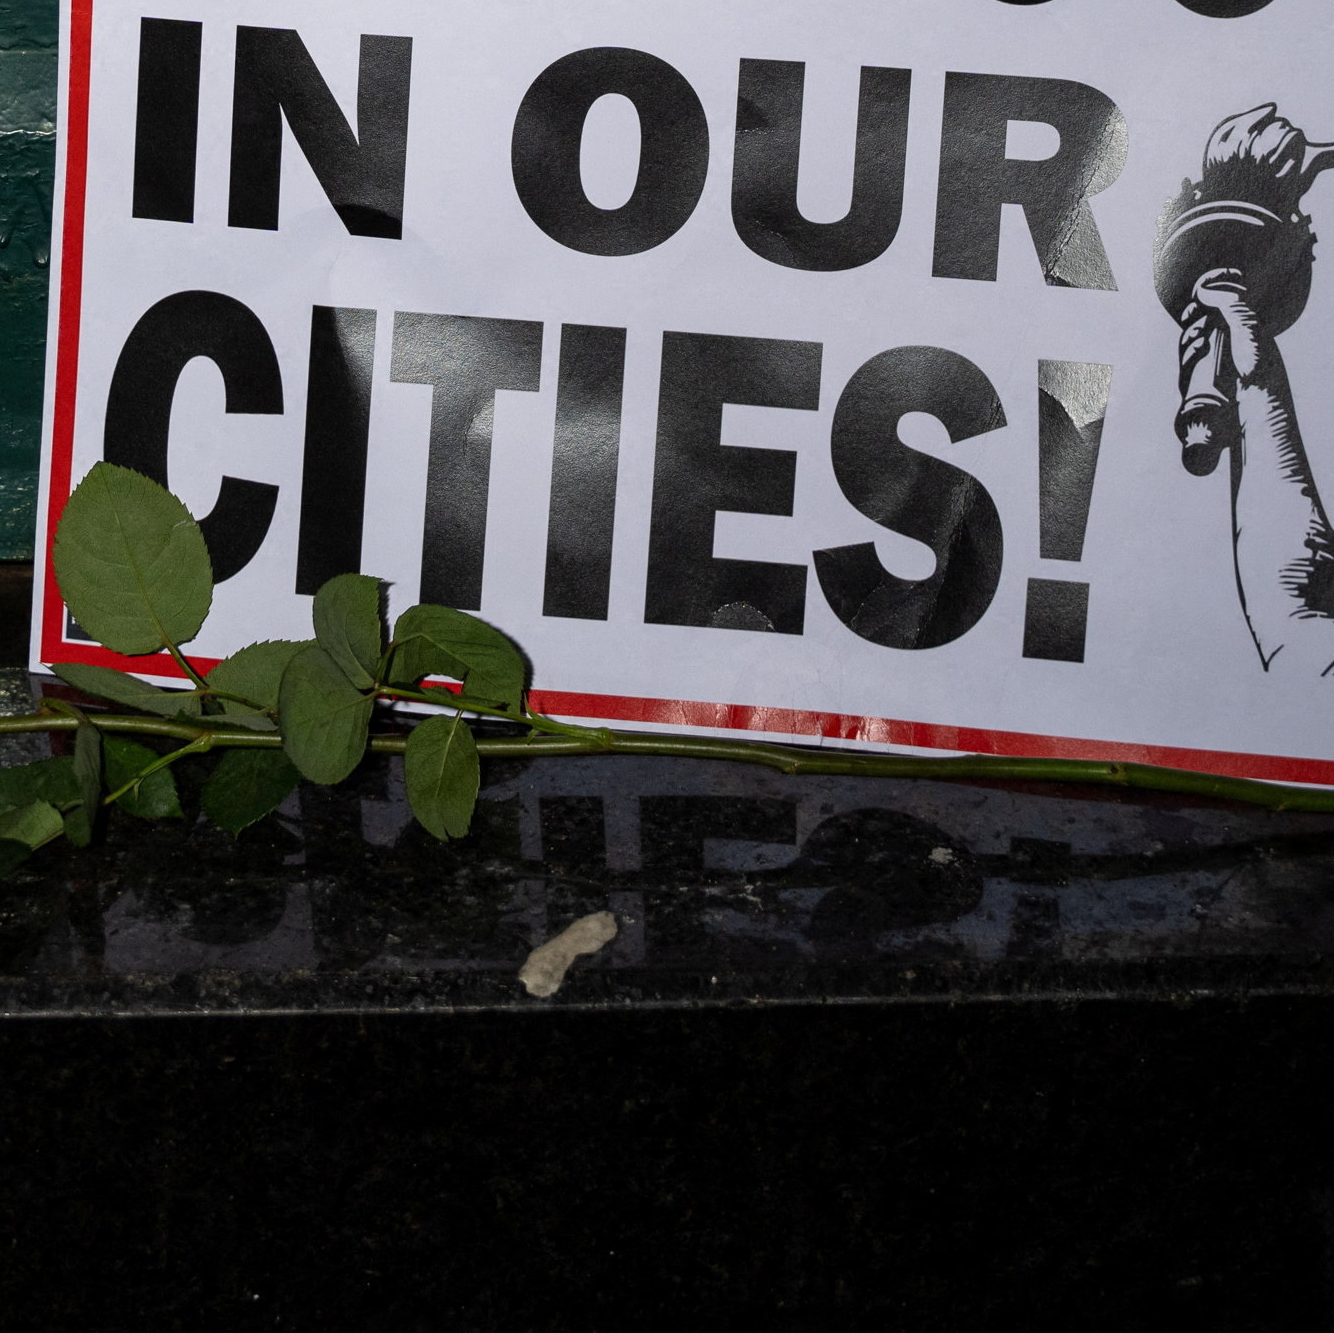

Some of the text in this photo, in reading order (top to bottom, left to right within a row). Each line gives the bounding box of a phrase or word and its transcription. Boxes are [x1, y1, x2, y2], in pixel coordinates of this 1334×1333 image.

[132, 17, 1129, 292] IN OUR
[104, 290, 1114, 664] CITIES!
